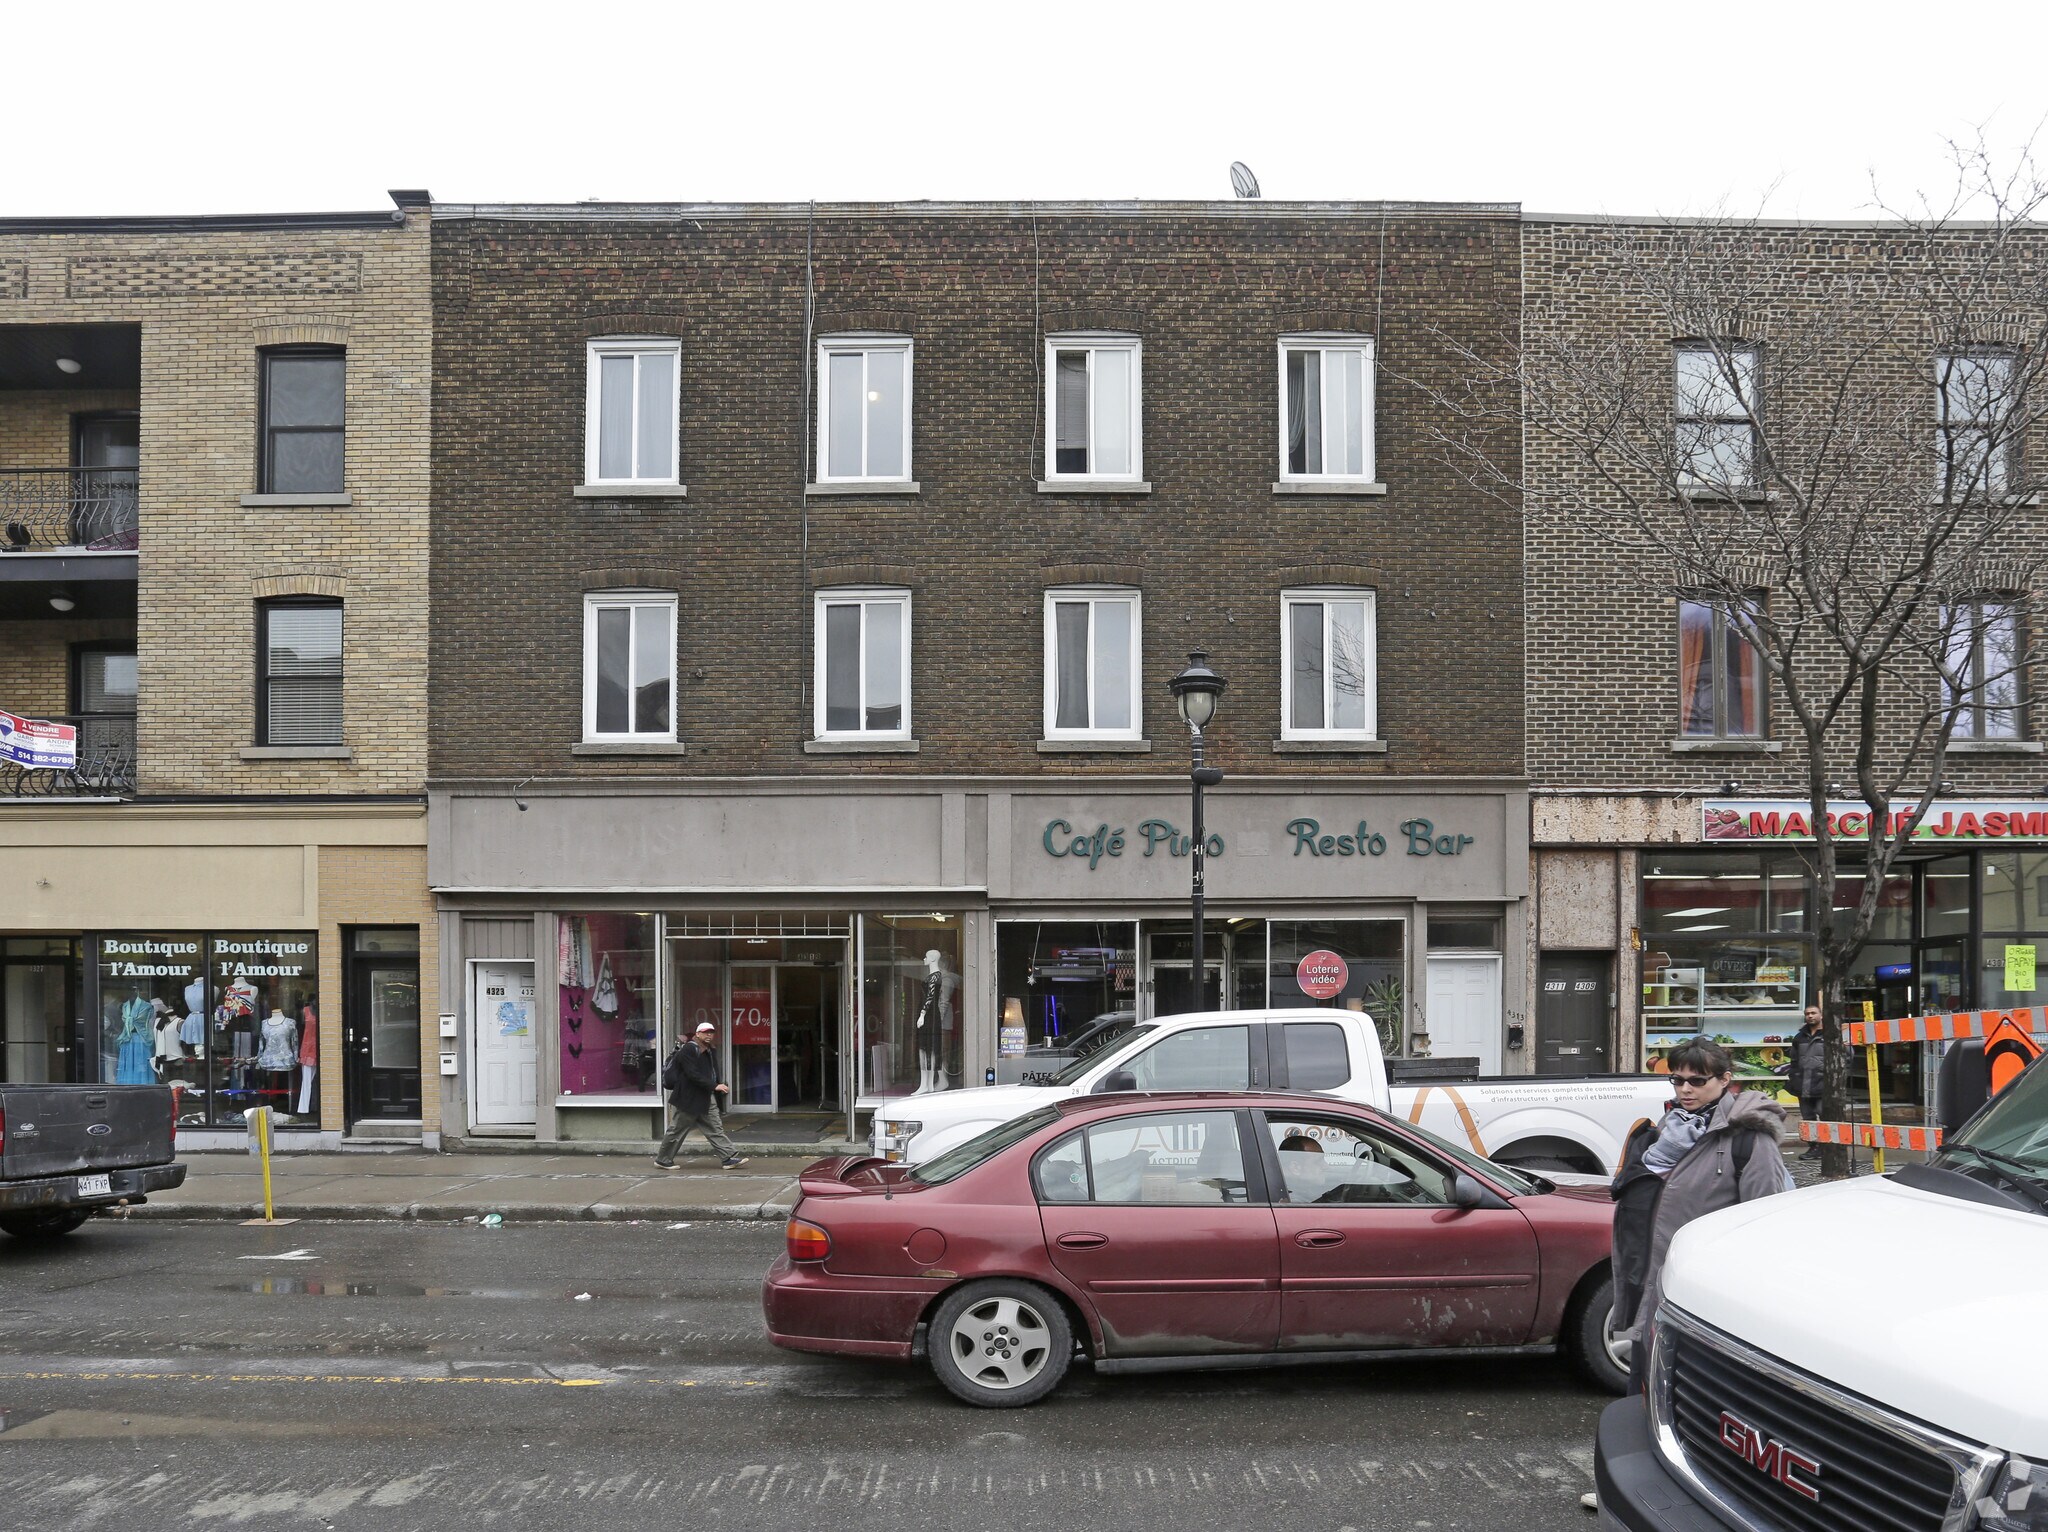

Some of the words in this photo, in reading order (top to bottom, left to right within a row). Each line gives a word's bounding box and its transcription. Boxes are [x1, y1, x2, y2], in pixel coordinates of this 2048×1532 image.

[28, 724, 60, 733] VENDRE
[18, 751, 31, 761] 514
[32, 754, 73, 764] 382-6789
[1043, 818, 1125, 870] Café
[1287, 818, 1387, 857] Resto
[1401, 818, 1474, 857] Bar
[104, 939, 198, 957] Boutique
[214, 939, 309, 957] Boutique
[111, 961, 192, 976] l'Amour
[221, 961, 303, 976] l'Amour
[1306, 964, 1339, 974] Loterie
[1713, 960, 1754, 972] OUVERT
[1310, 974, 1336, 984] vidéo
[486, 987, 505, 996] 4323
[1544, 982, 1566, 990] 4311
[1575, 982, 1596, 990] 4309
[733, 1008, 771, 1027] 70%
[1507, 1009, 1524, 1021] 4313
[1718, 1410, 1822, 1502] GMC
